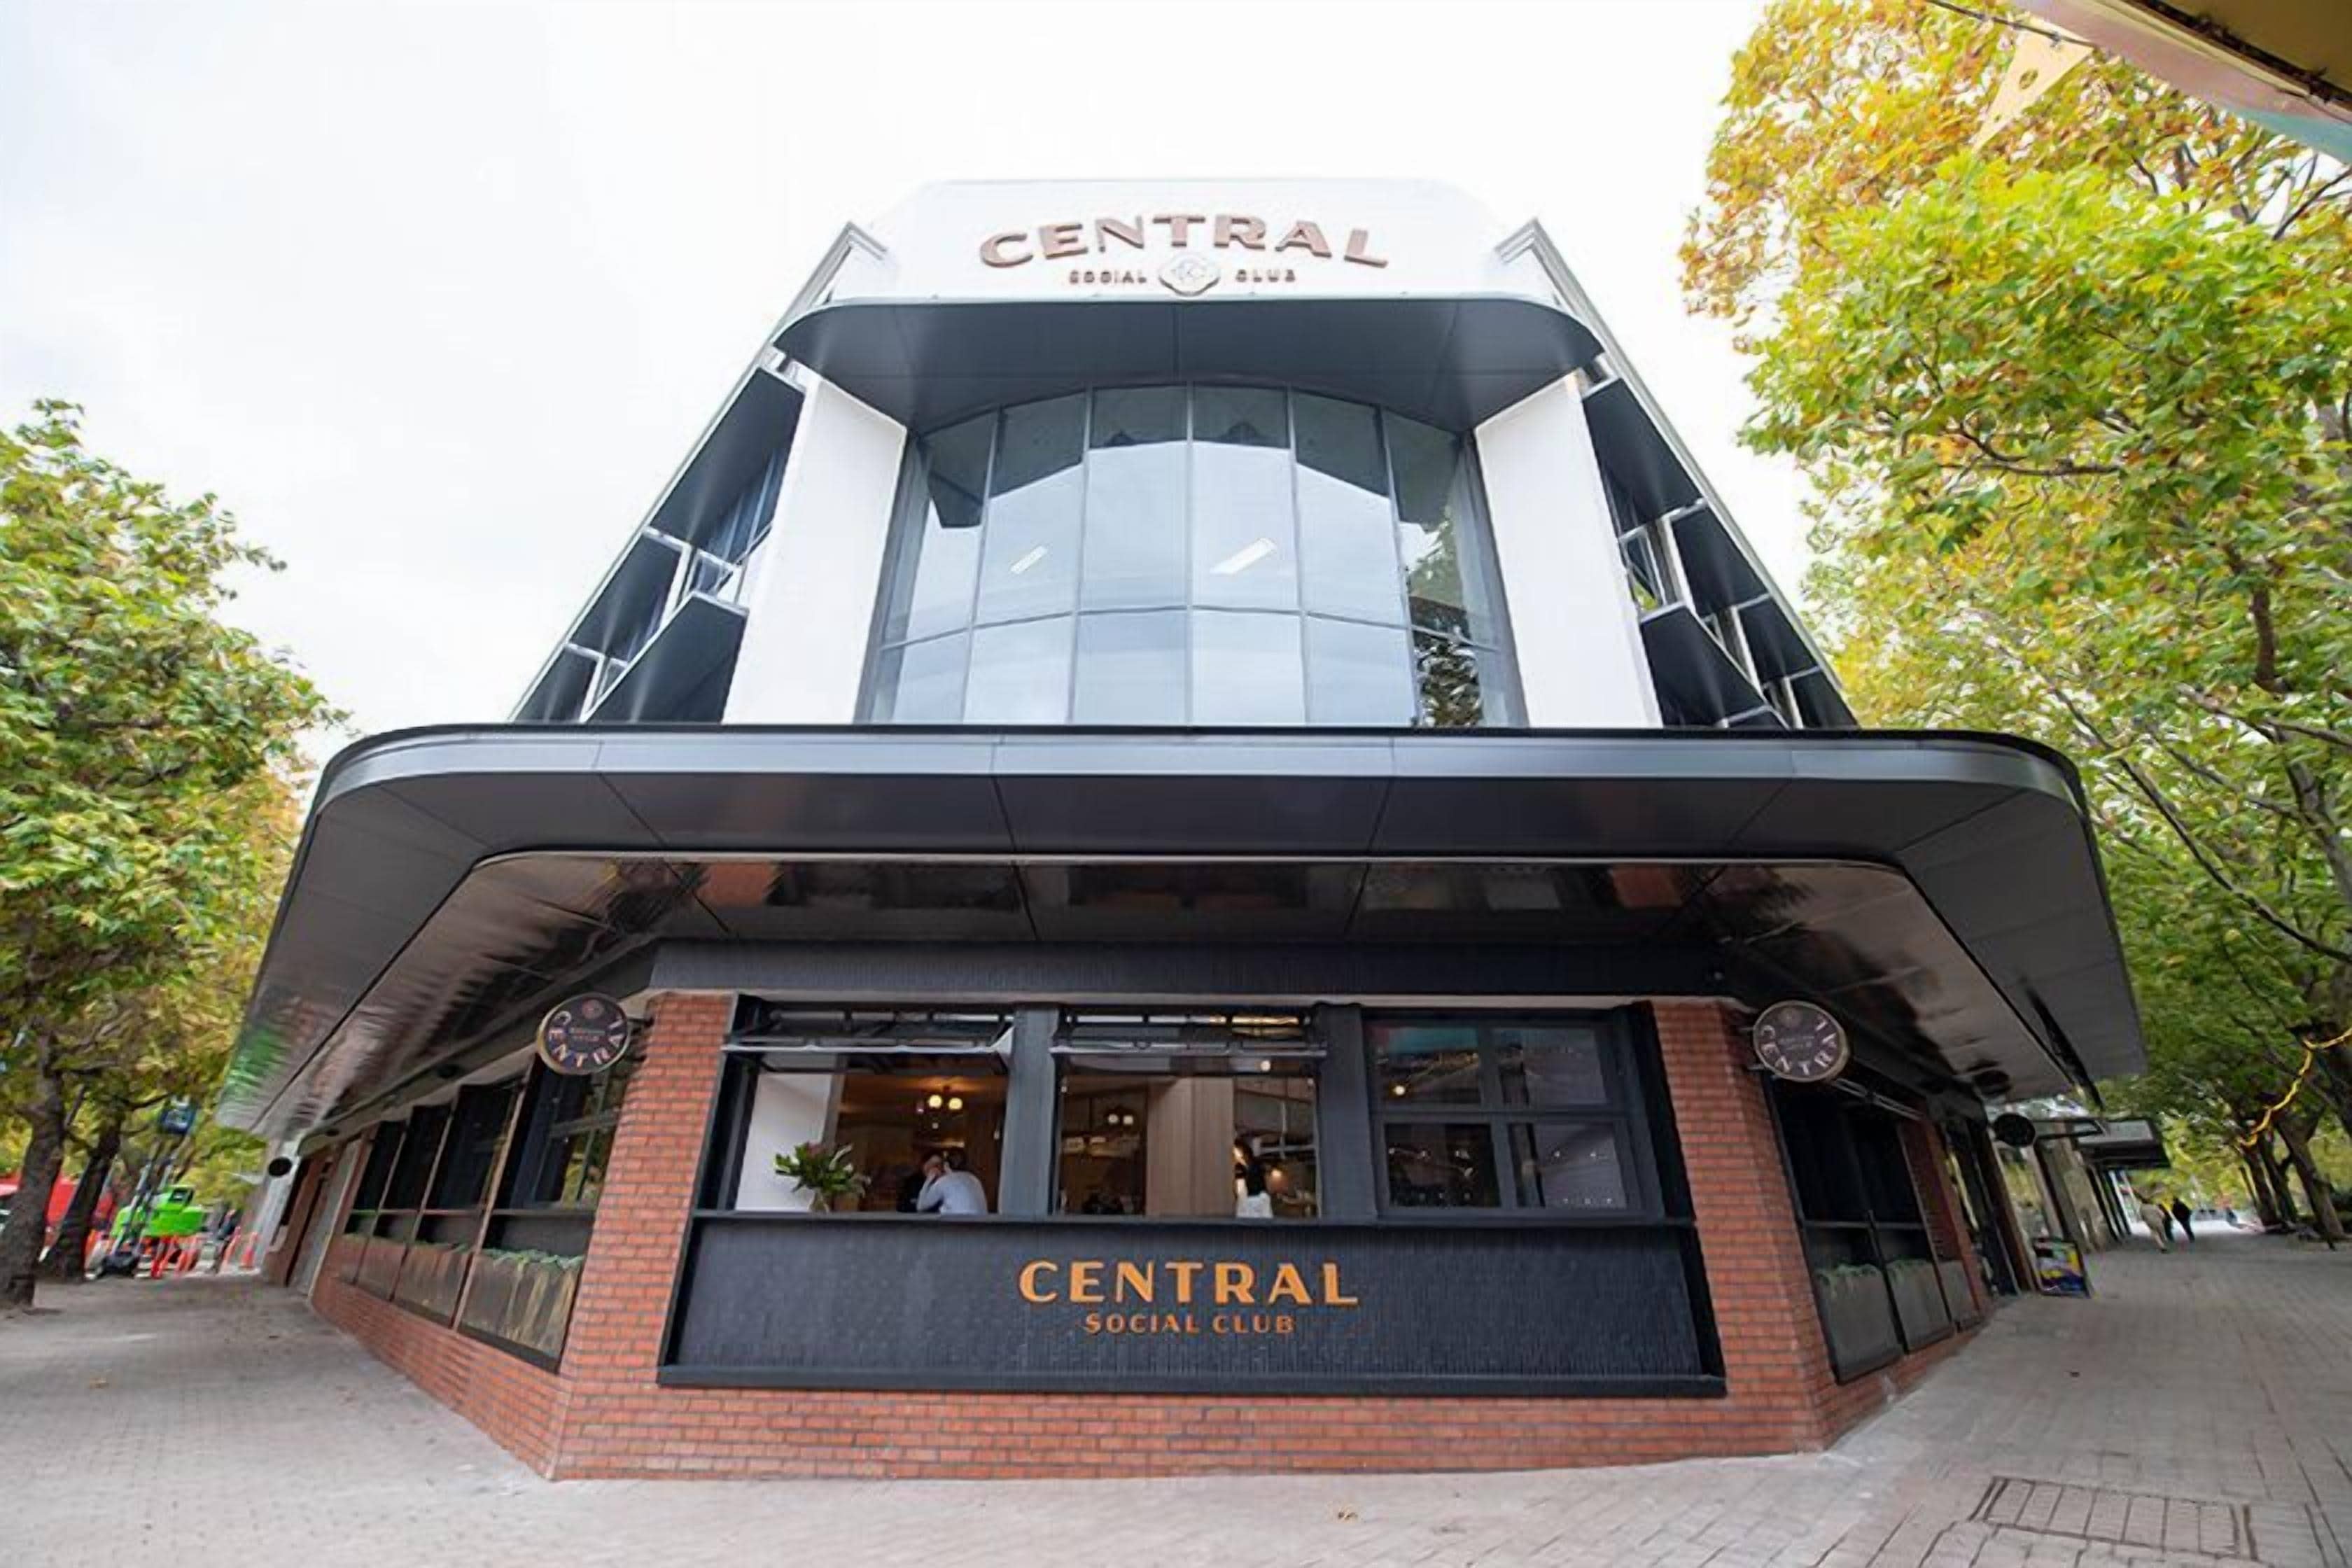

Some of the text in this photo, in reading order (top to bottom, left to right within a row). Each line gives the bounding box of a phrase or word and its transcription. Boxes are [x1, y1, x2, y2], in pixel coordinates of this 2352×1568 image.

[979, 215, 1389, 268] CENTRAL
[548, 1011, 626, 1068] CENTRAL
[1018, 1259, 1359, 1306] CENTRAL
[1084, 1313, 1296, 1334] SOCIAL CLUB
